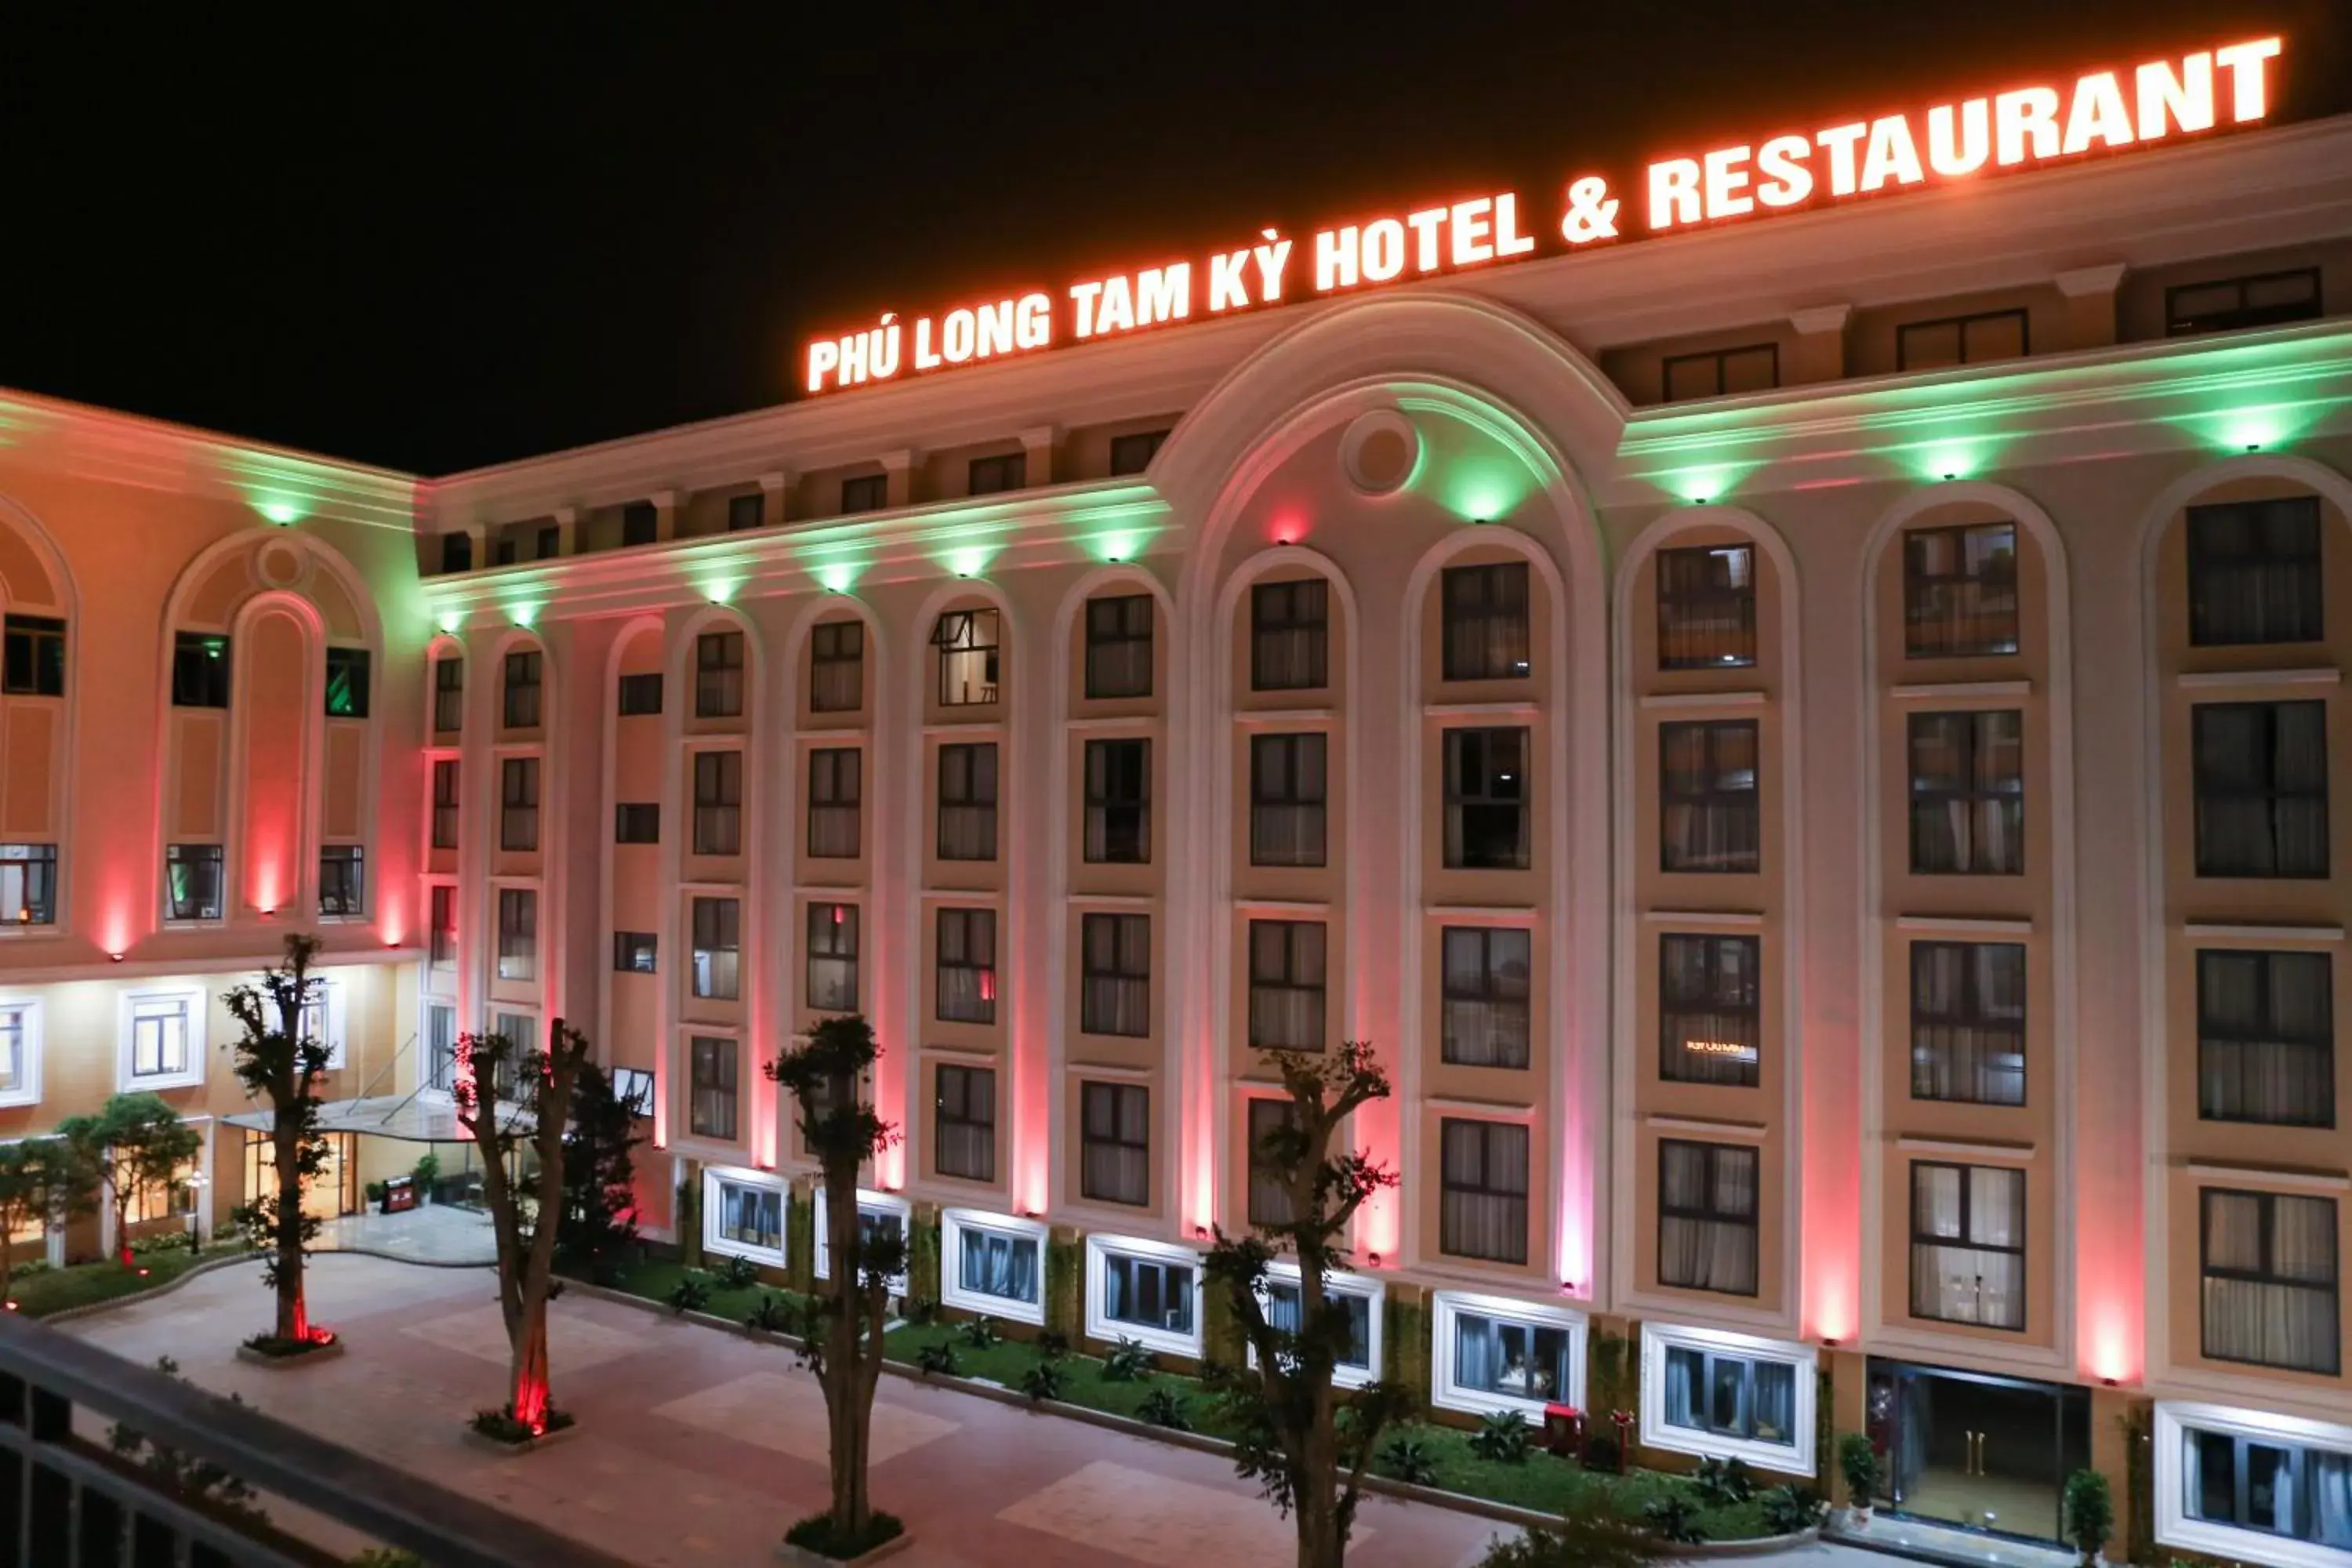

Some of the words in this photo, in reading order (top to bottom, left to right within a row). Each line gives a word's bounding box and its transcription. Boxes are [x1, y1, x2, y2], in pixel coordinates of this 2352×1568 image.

[808, 311, 900, 392] PHÚ
[915, 293, 1051, 369] LONG
[1069, 263, 1191, 338] TAM
[1208, 227, 1293, 311] KỲ
[1316, 192, 1534, 291] HOTEL
[1562, 176, 1620, 243] &
[1648, 38, 2281, 229] RESTAURANT
